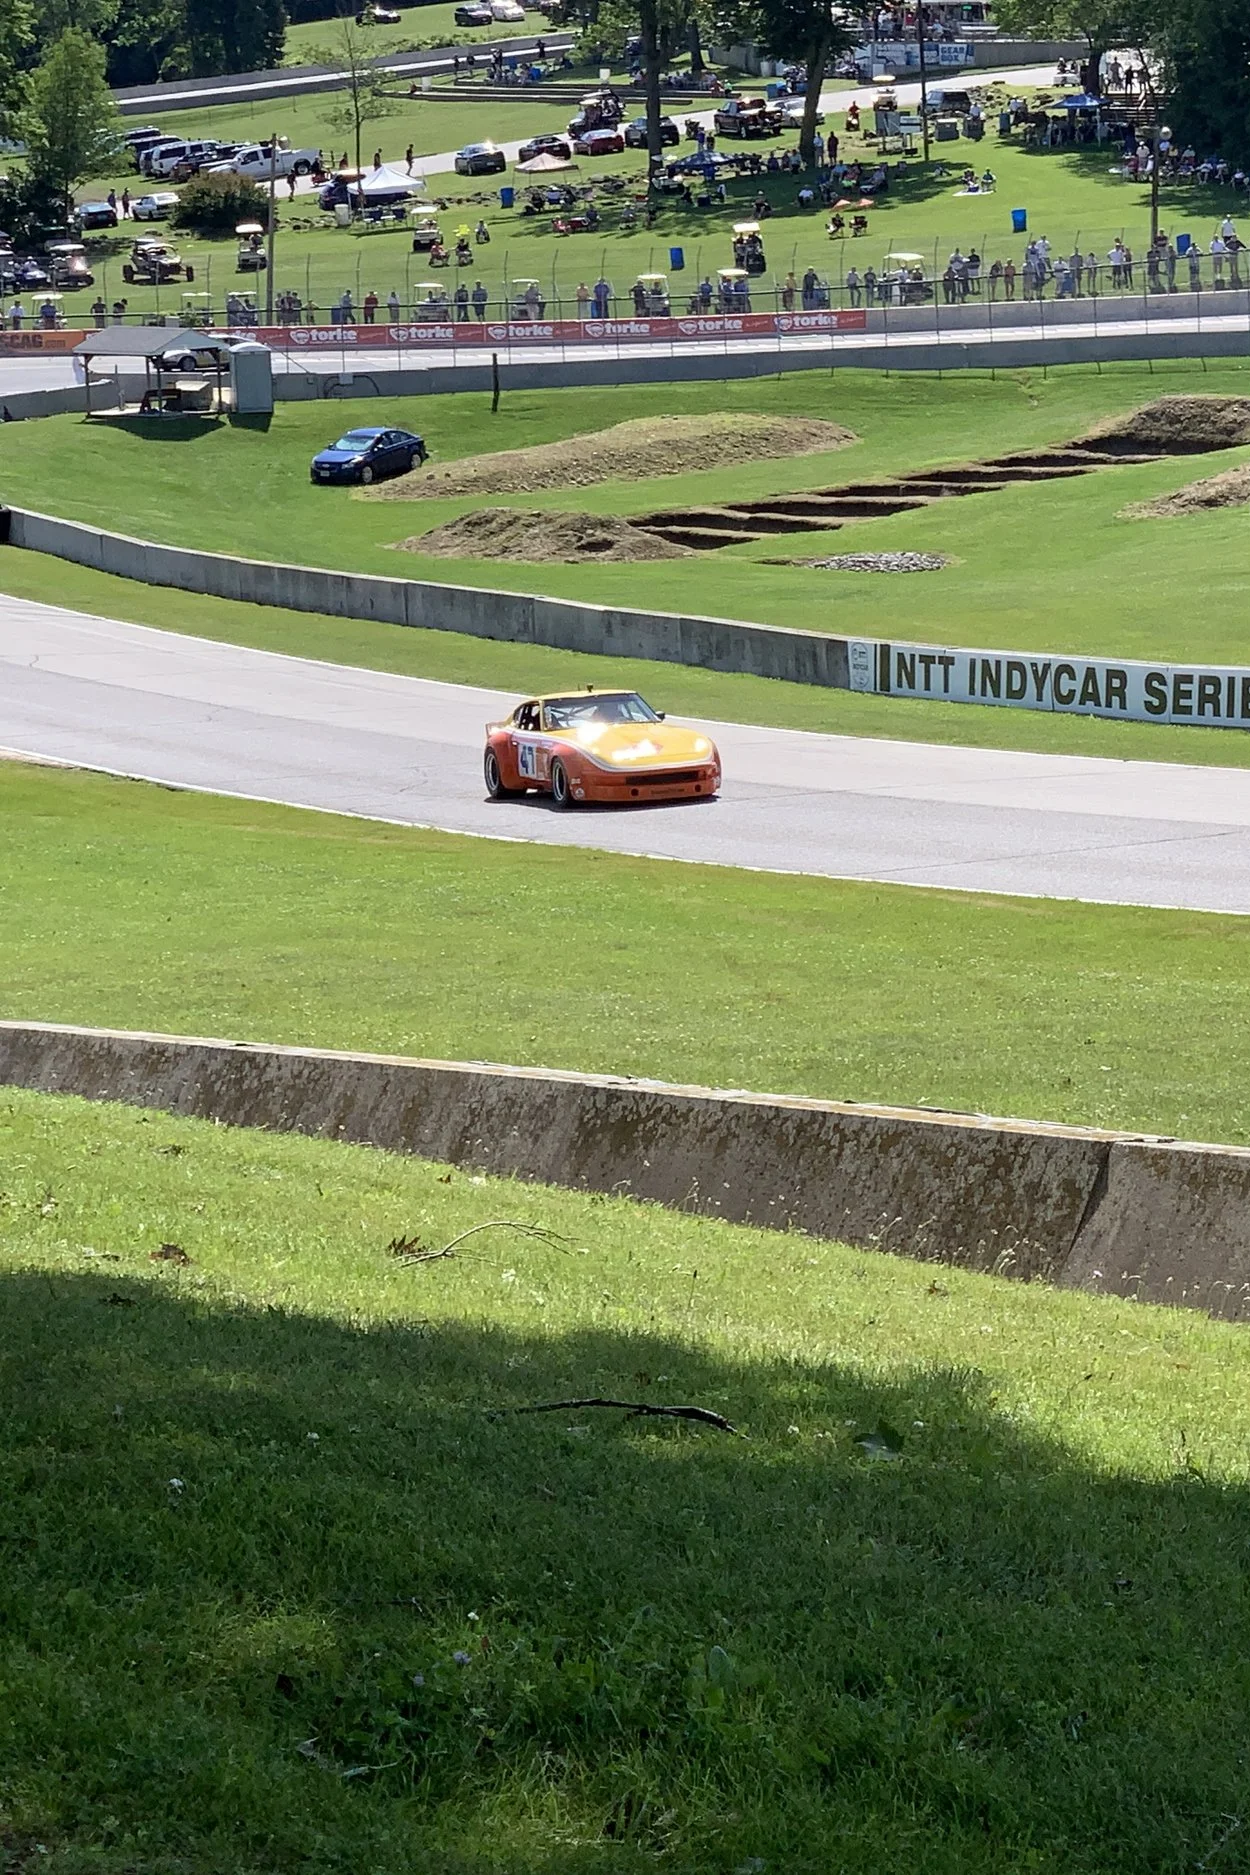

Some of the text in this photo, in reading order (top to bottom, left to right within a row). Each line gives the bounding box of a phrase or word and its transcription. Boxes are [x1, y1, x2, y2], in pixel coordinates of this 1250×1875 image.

[698, 317, 743, 330] torke
[792, 314, 838, 327] torke
[310, 328, 357, 341] torke
[410, 325, 454, 339] torke
[508, 324, 553, 337] torke
[604, 322, 650, 334] torke
[896, 652, 956, 694] NTT
[968, 658, 1128, 711] INDYCAR
